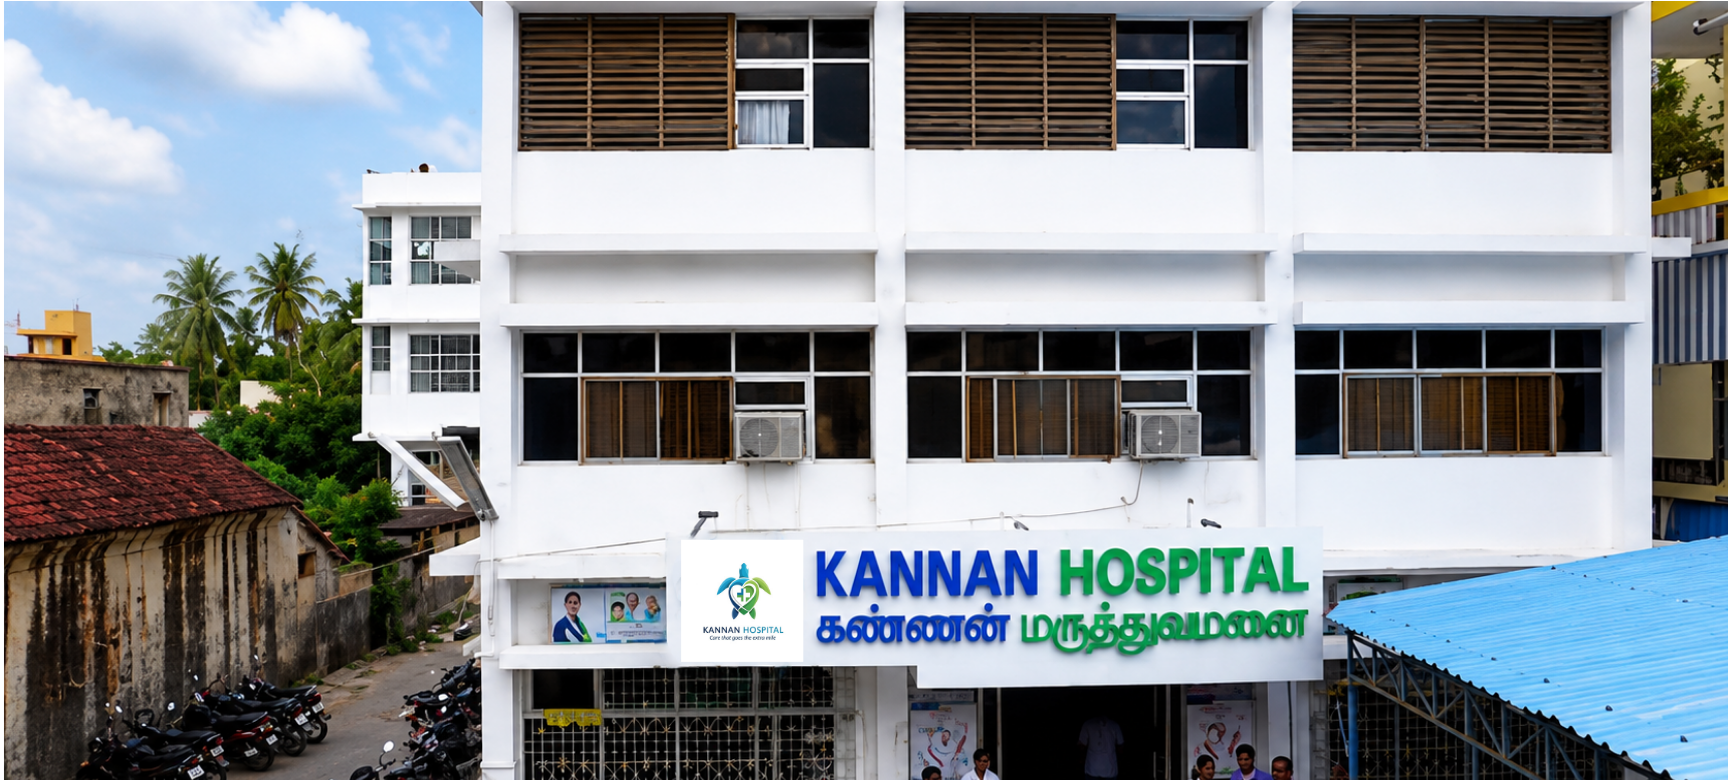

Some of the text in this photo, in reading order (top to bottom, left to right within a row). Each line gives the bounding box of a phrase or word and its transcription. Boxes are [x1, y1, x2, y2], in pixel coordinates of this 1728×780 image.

[816, 546, 1309, 597] KANNAN HOSPITAL
[702, 626, 784, 634] KANNAN HOSPITAL
[816, 601, 1309, 655] கண்ணன் மருத்துவமனை
